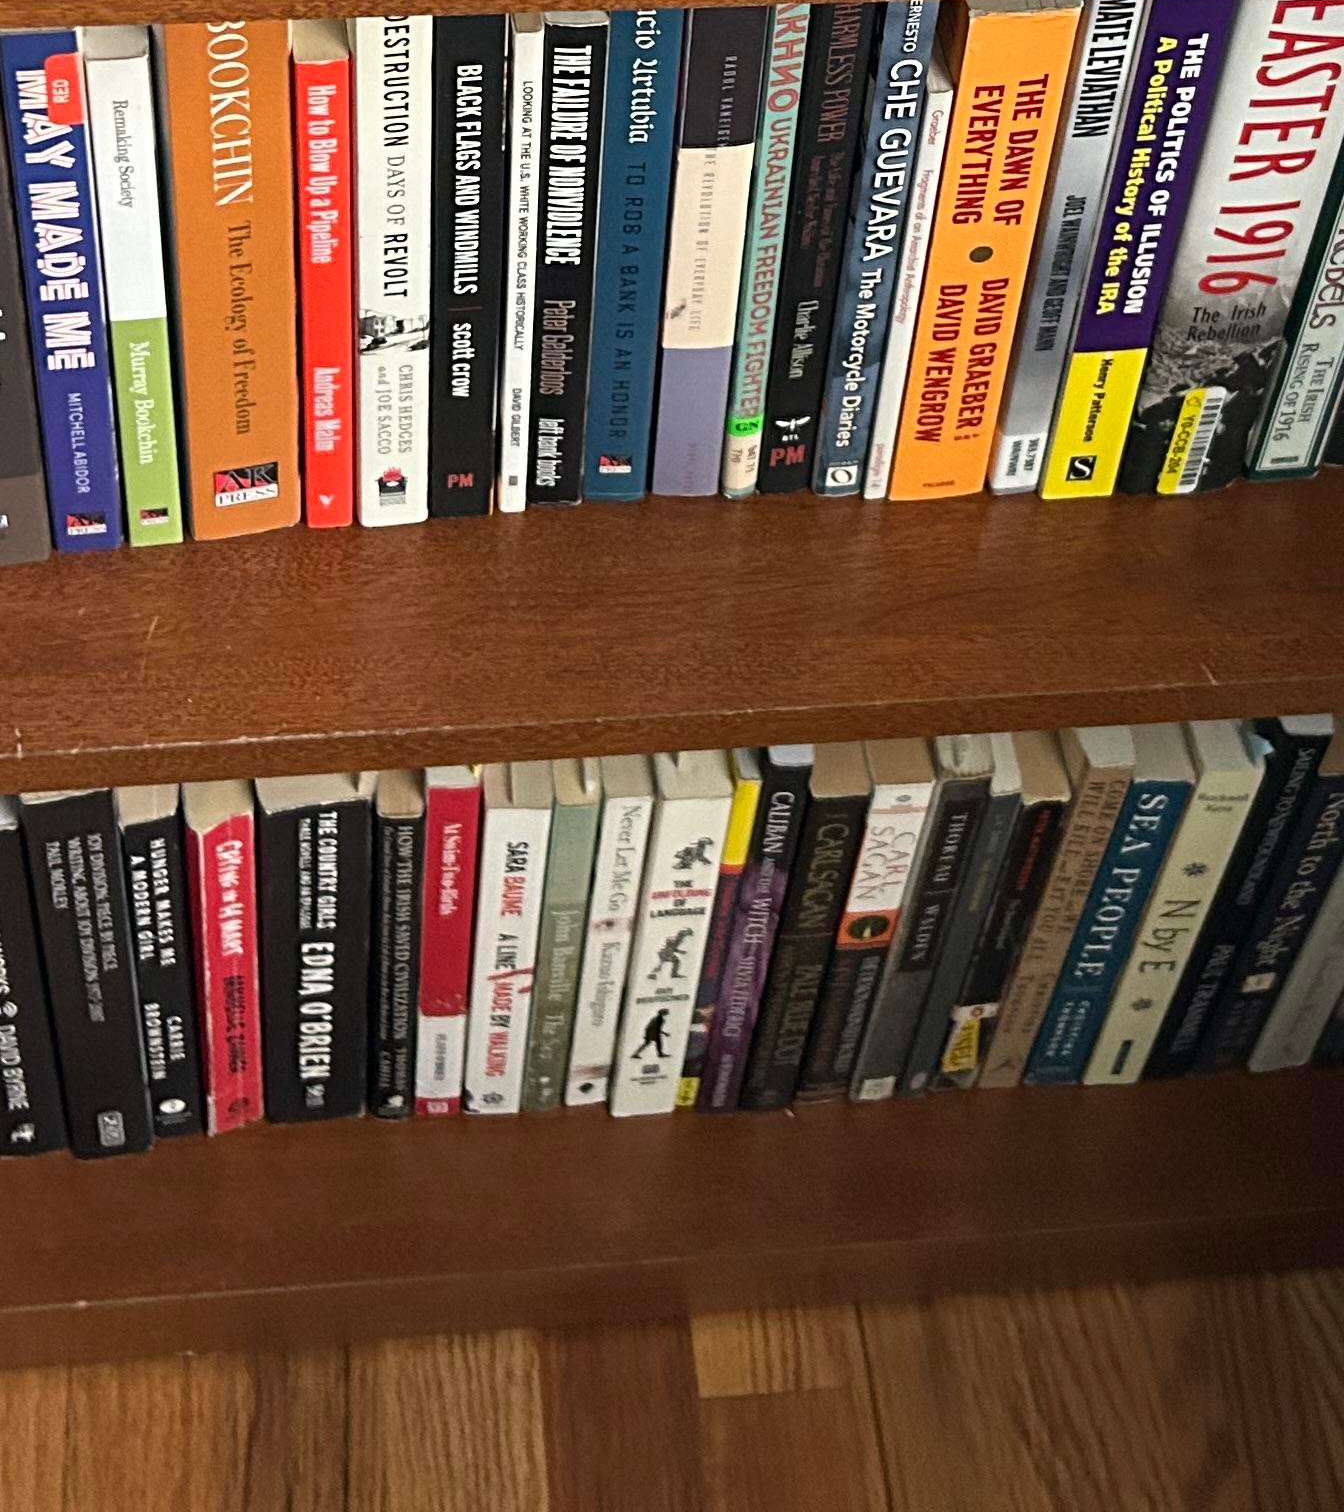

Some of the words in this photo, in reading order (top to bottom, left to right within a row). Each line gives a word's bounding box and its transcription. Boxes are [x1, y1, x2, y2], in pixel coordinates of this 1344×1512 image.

[1156, 36, 1178, 53] A
[1180, 33, 1209, 79] THE
[457, 64, 483, 118] BLACK
[522, 80, 533, 123] LOOKING
[884, 59, 923, 120] CHE
[1012, 73, 1049, 121] THE
[1136, 59, 1173, 142] Political
[112, 100, 133, 164] Remaking
[456, 121, 482, 171] FLAGS
[521, 142, 532, 160] THE
[522, 127, 532, 140] AT
[952, 84, 1005, 225] EVERYTHING
[1156, 86, 1196, 183] POLITICS
[520, 163, 531, 182] U.S.
[999, 129, 1038, 191] DAWN
[1115, 148, 1152, 216] History
[118, 166, 135, 208] Society
[456, 175, 480, 206] AND
[519, 186, 529, 214] WHITE
[863, 128, 912, 262] GUEVARA
[1148, 189, 1170, 217] OF
[994, 200, 1025, 227] OF
[1113, 222, 1132, 242] of
[454, 208, 480, 294] WINDMILLS
[517, 216, 529, 258] WORKING
[1198, 200, 1302, 295] 1916
[517, 261, 527, 290] CLASS
[858, 268, 882, 299] The
[1105, 247, 1128, 277] the
[1123, 223, 1162, 314] ILLUSION
[514, 292, 528, 350] HISTORICALLY
[1096, 281, 1120, 315] IRA
[453, 322, 475, 360] scott
[843, 304, 875, 392] Motorcycle
[129, 342, 150, 394] Murray
[452, 363, 470, 397] crow
[135, 398, 158, 464] Bookchin
[836, 395, 861, 448] Diaries
[448, 473, 474, 488] PM
[318, 811, 338, 835] THE
[763, 791, 795, 853] CALIBAN
[1120, 793, 1169, 854] SEA
[149, 838, 169, 895] HUNGER
[318, 838, 338, 893] COUNTRY
[505, 841, 529, 873] SARA
[317, 895, 337, 930] GIRLS
[501, 877, 525, 917] BAUME
[1160, 899, 1201, 917] N
[156, 899, 174, 943] MAKES
[1074, 867, 1141, 978] PEOPLE
[298, 942, 335, 995] EDNA
[1139, 960, 1176, 973] E
[299, 1001, 333, 1079] O'BRIEN
